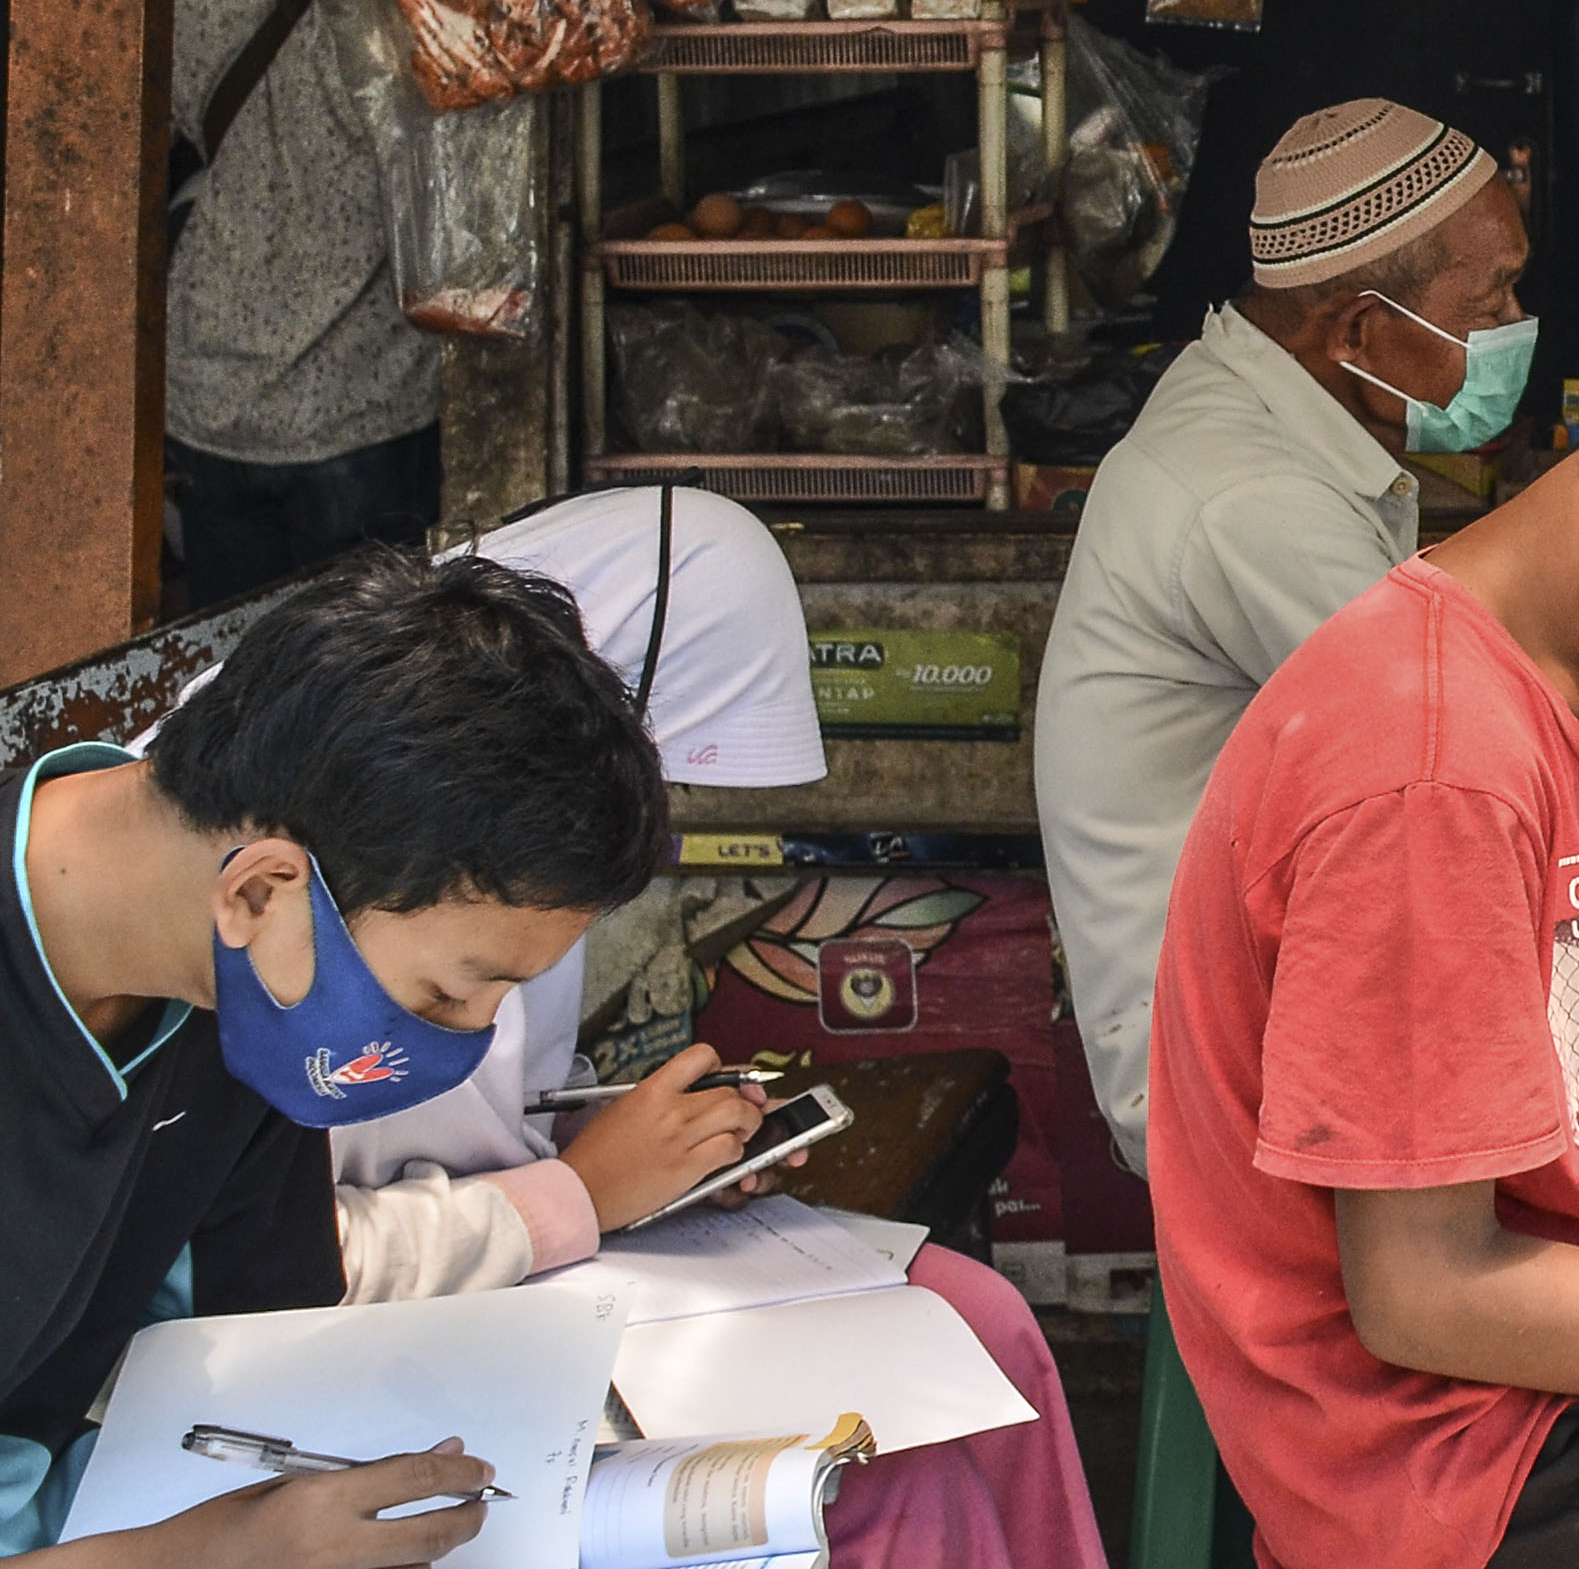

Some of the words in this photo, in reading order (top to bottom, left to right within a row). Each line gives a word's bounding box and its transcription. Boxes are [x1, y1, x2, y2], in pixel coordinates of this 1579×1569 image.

[809, 643, 882, 663] TRA
[912, 664, 993, 685] 10.000
[818, 687, 875, 700] NTAP
[718, 843, 770, 858] LET'S
